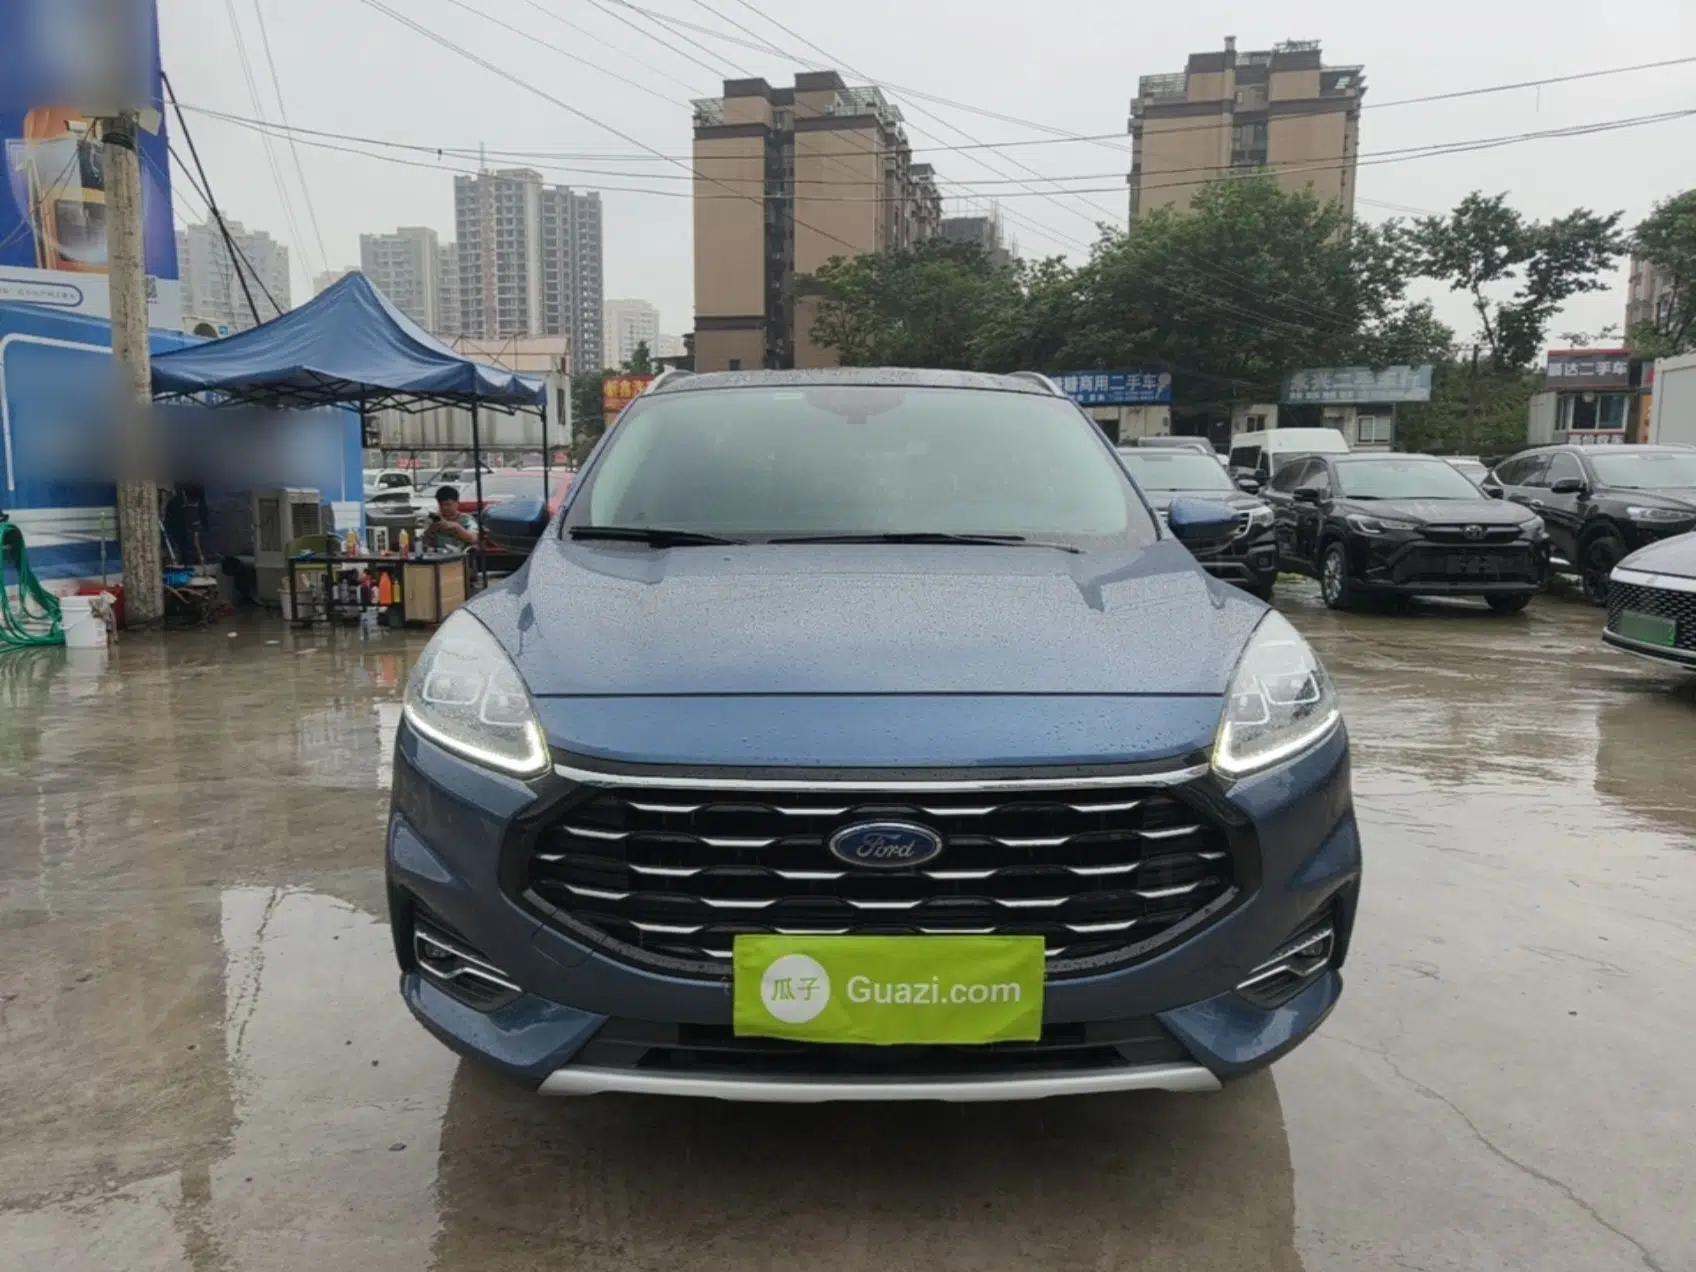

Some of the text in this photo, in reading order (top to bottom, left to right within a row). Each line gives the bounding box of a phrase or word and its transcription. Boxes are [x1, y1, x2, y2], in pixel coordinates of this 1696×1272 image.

[856, 833, 915, 857] Ford
[771, 977, 821, 1001] 瓜子
[847, 976, 1021, 1004] Guazi.com
